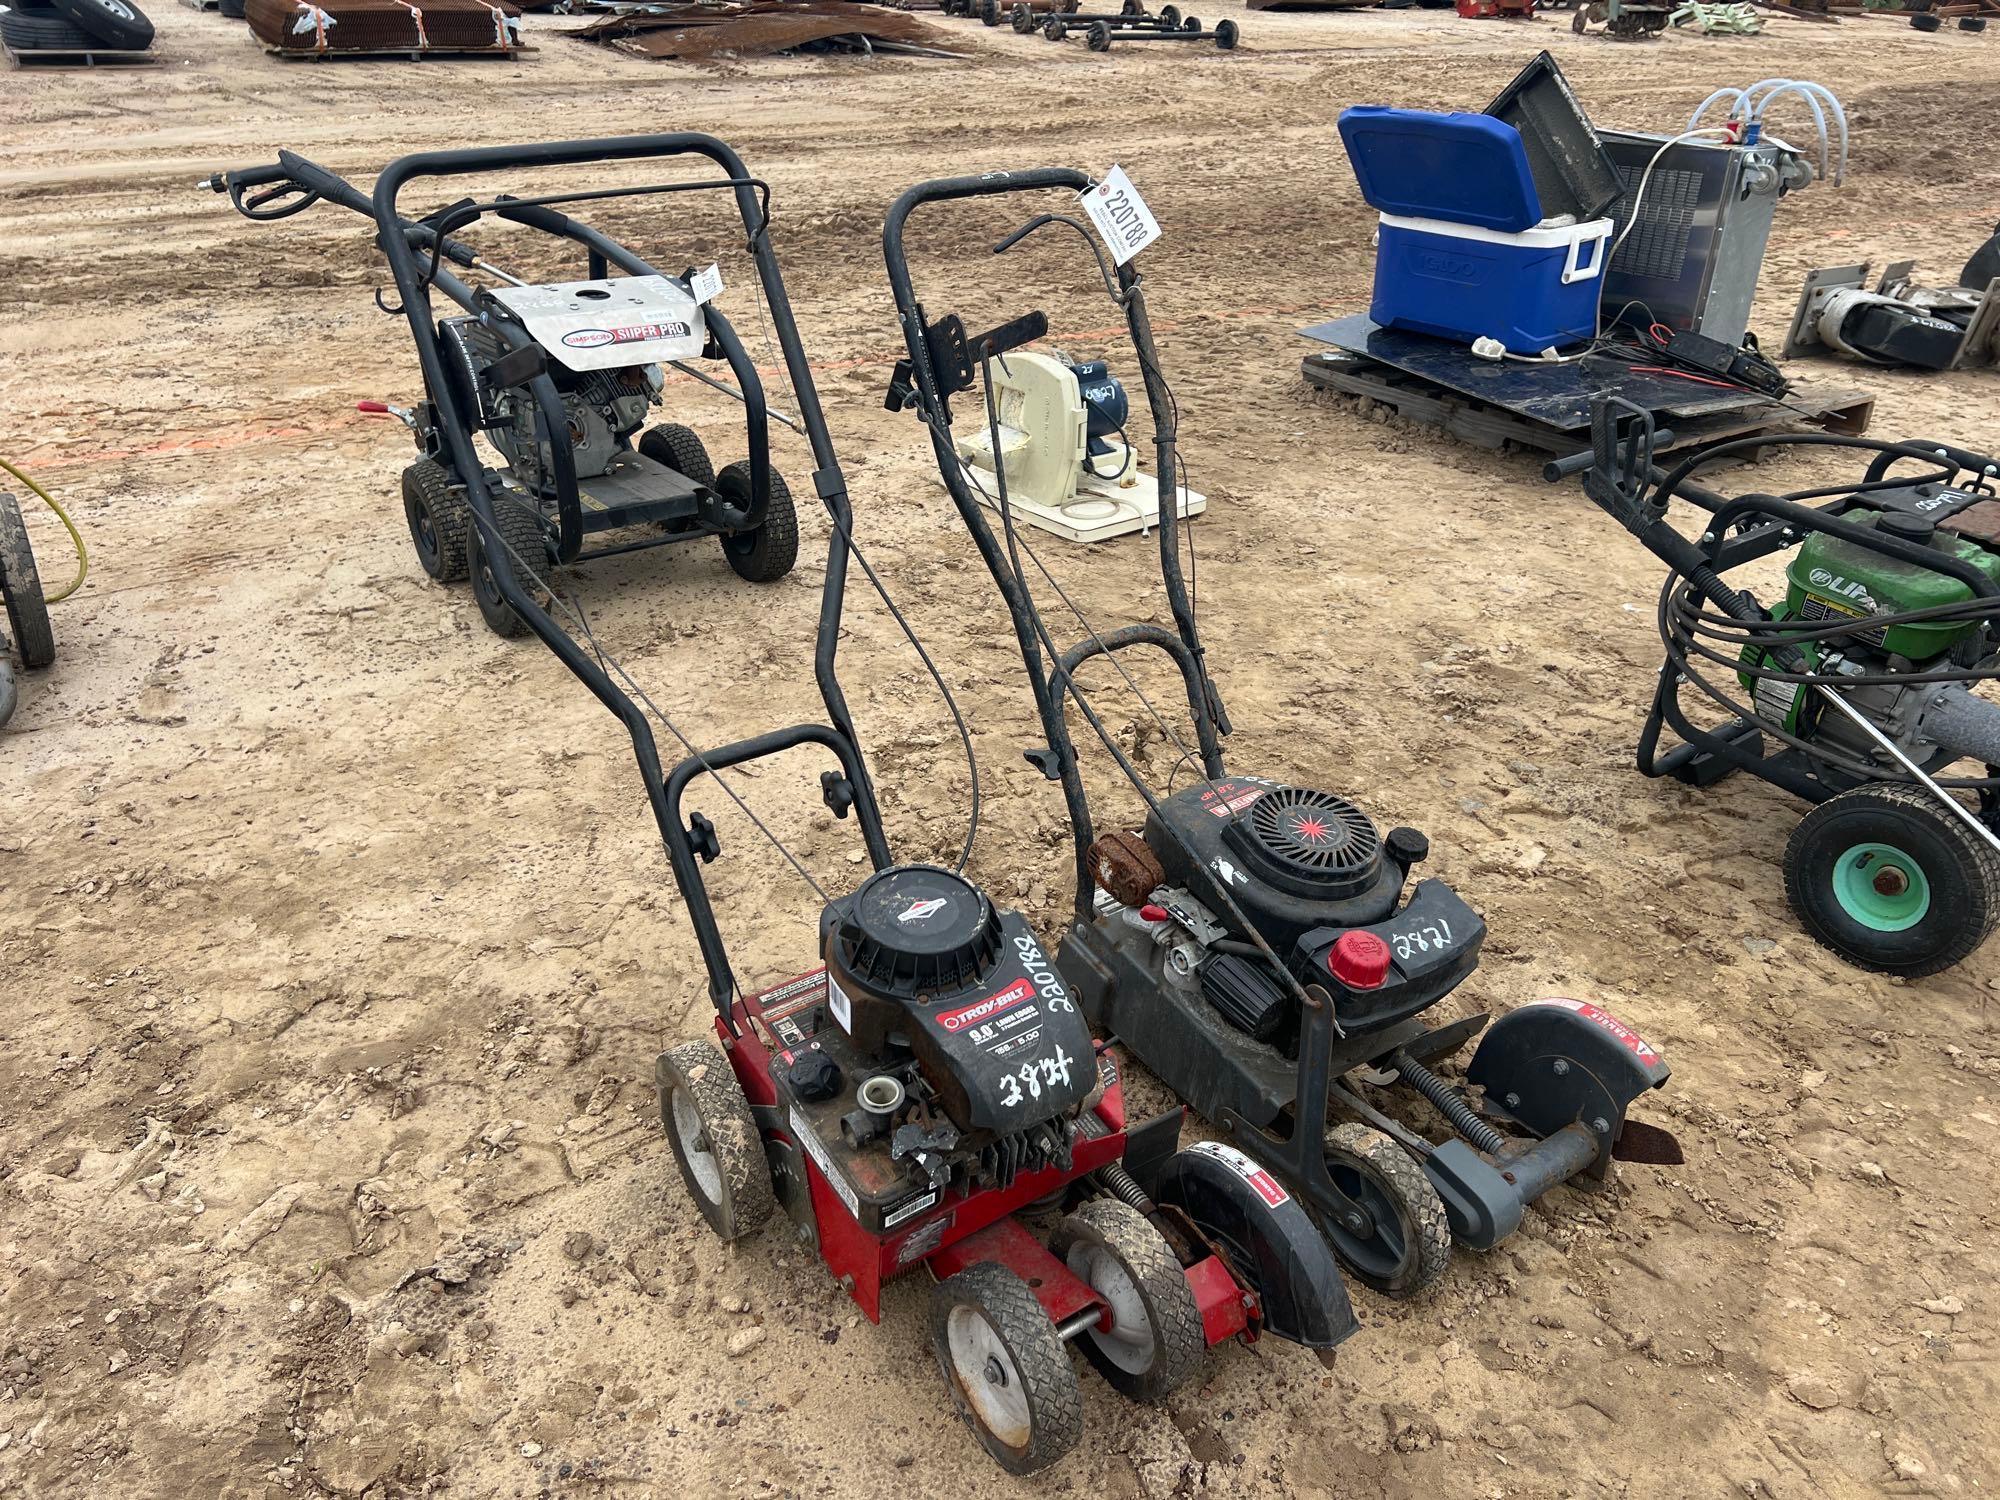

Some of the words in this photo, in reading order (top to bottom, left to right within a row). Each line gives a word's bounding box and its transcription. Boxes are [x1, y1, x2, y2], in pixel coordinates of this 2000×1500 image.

[1104, 189, 1149, 248] 220788
[566, 333, 611, 345] SIMPSON
[617, 324, 658, 340] SUPER
[660, 321, 686, 336] PRO
[1392, 918, 1453, 960] 2821
[1013, 934, 1075, 1013] 220788
[956, 986, 1025, 1023] TROY-BILT
[995, 1014, 1017, 1028] LAWN
[1014, 1004, 1037, 1019] EDGER
[1590, 1012, 1629, 1039] DANGER
